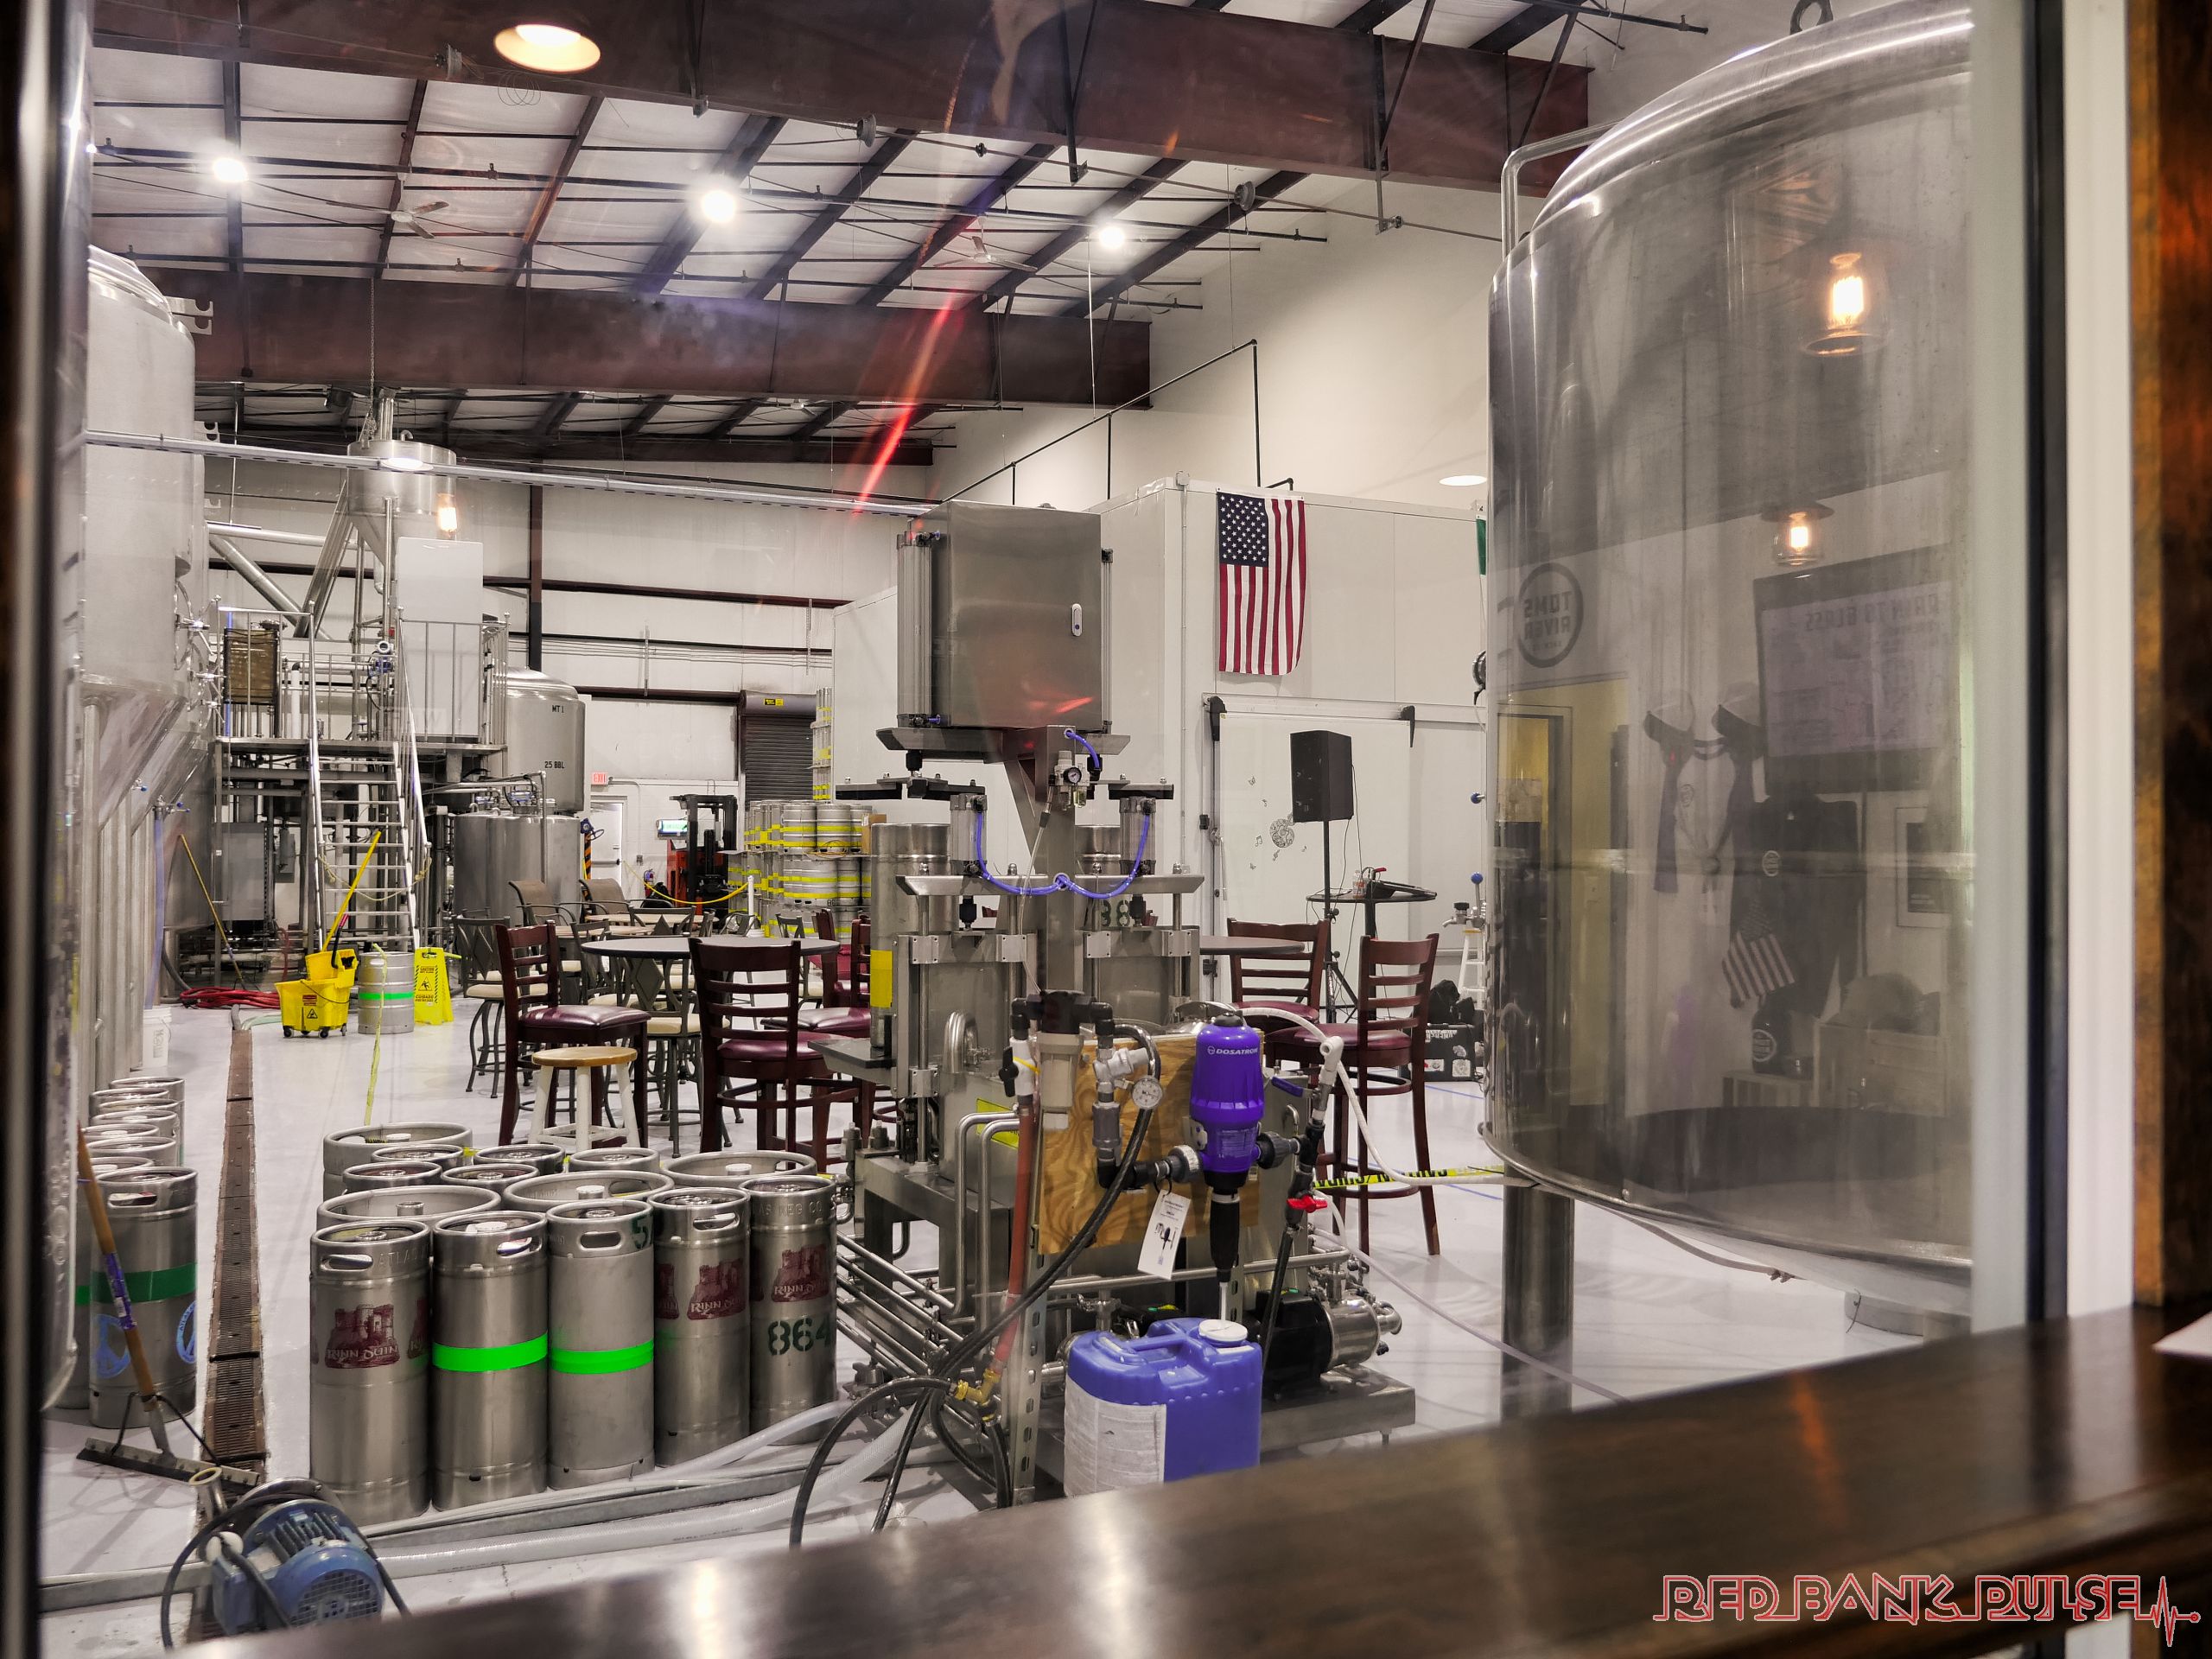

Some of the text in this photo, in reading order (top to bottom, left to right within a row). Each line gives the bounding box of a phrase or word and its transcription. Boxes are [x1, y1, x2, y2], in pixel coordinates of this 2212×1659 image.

[594, 773, 607, 783] EXIT
[691, 1300, 721, 1313] RINN
[768, 1314, 830, 1356] 864
